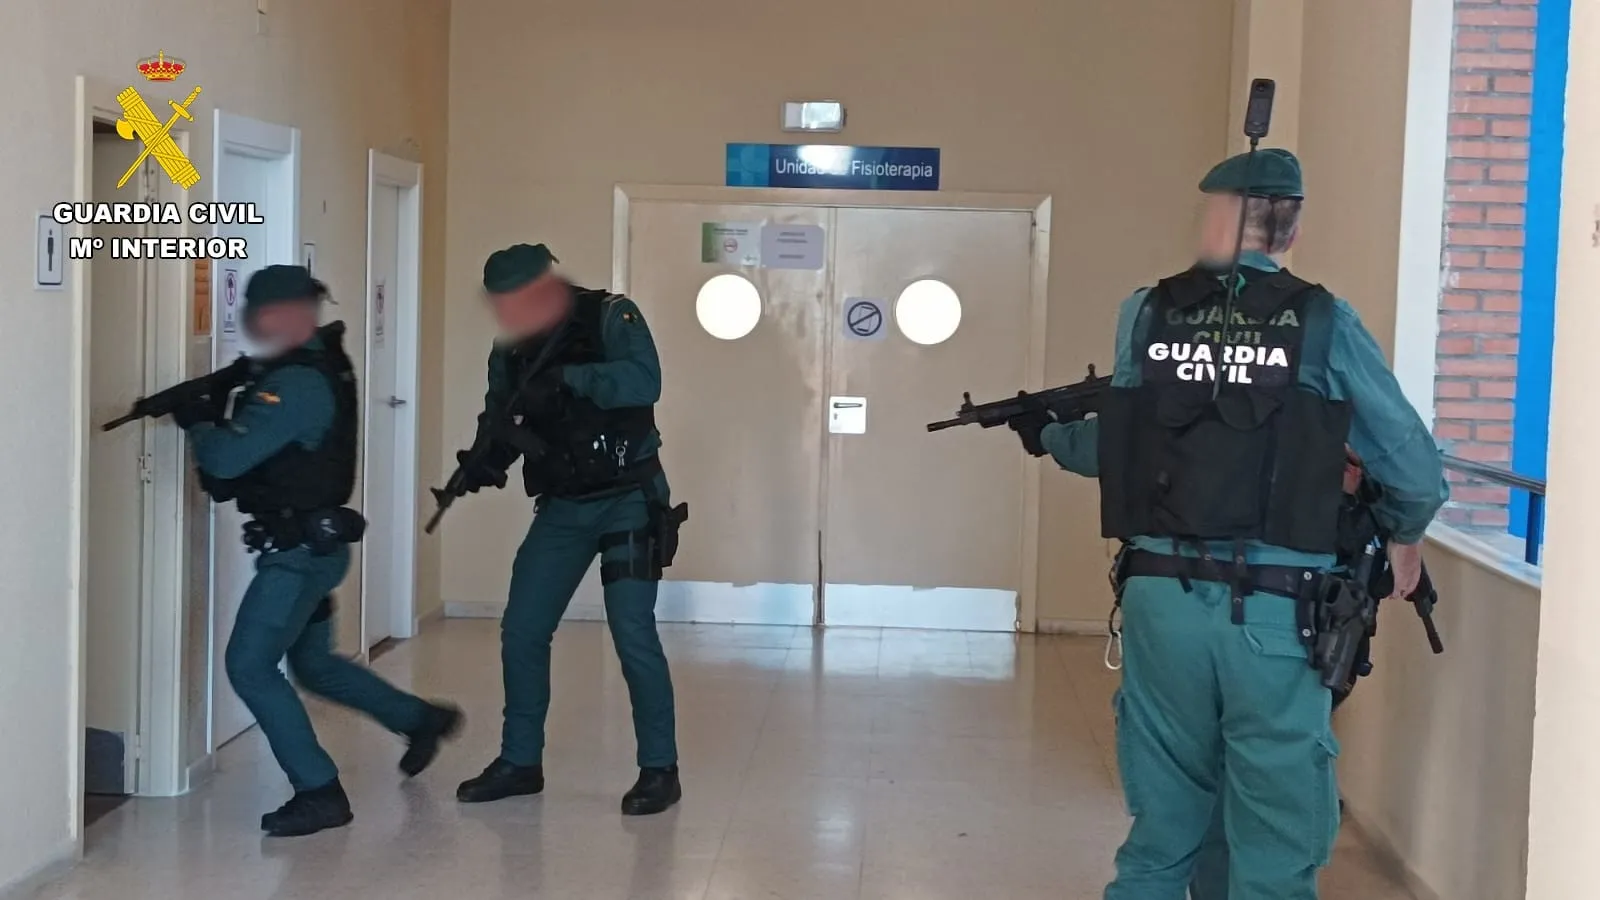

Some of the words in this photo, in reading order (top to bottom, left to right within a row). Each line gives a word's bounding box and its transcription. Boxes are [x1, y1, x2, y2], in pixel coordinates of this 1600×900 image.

[775, 158, 827, 175] Unida
[852, 160, 933, 180] Fisioterapia
[1165, 305, 1300, 328] GUARA
[1147, 342, 1289, 368] GUARDIA
